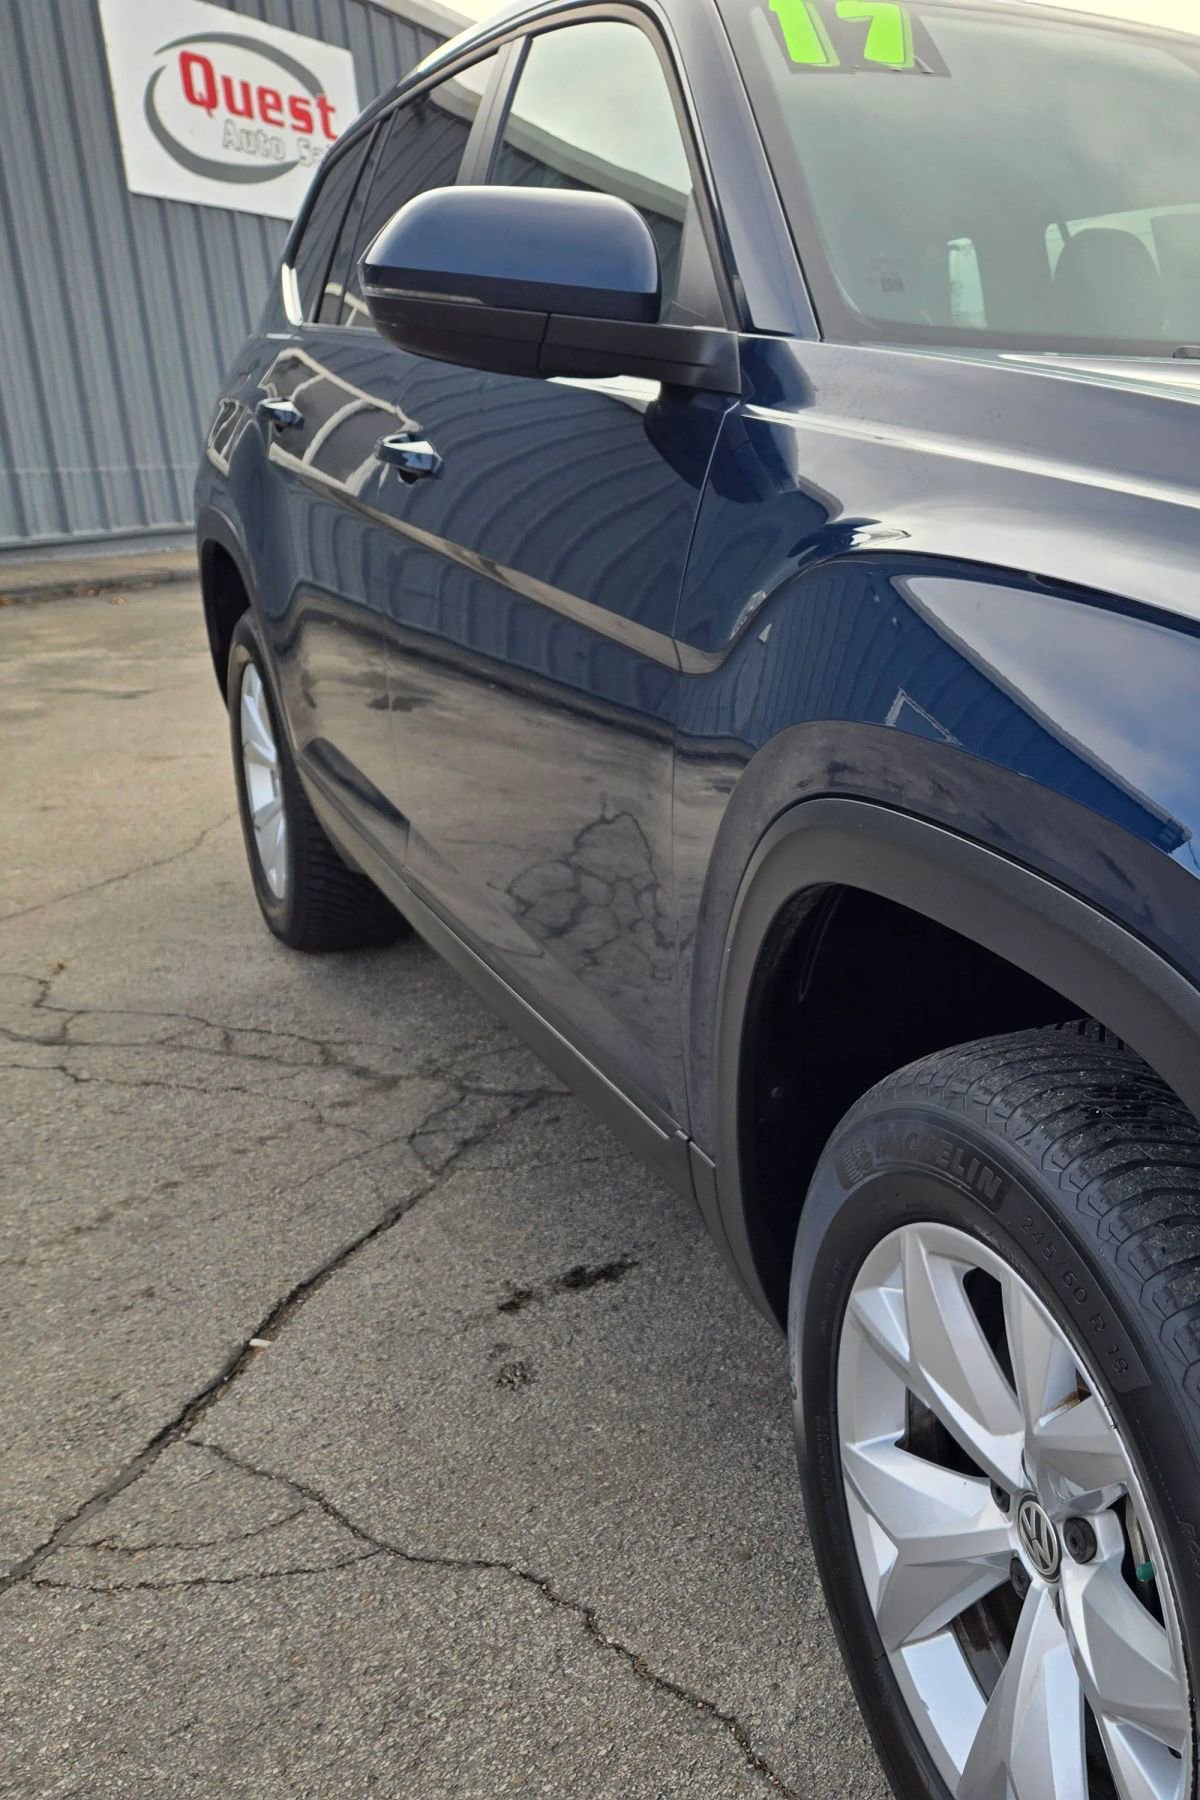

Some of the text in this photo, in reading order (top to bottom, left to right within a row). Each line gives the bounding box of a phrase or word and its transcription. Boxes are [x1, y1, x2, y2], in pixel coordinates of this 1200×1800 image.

[768, 0, 916, 68] 17
[178, 50, 339, 142] Quest
[221, 119, 288, 162] Auto
